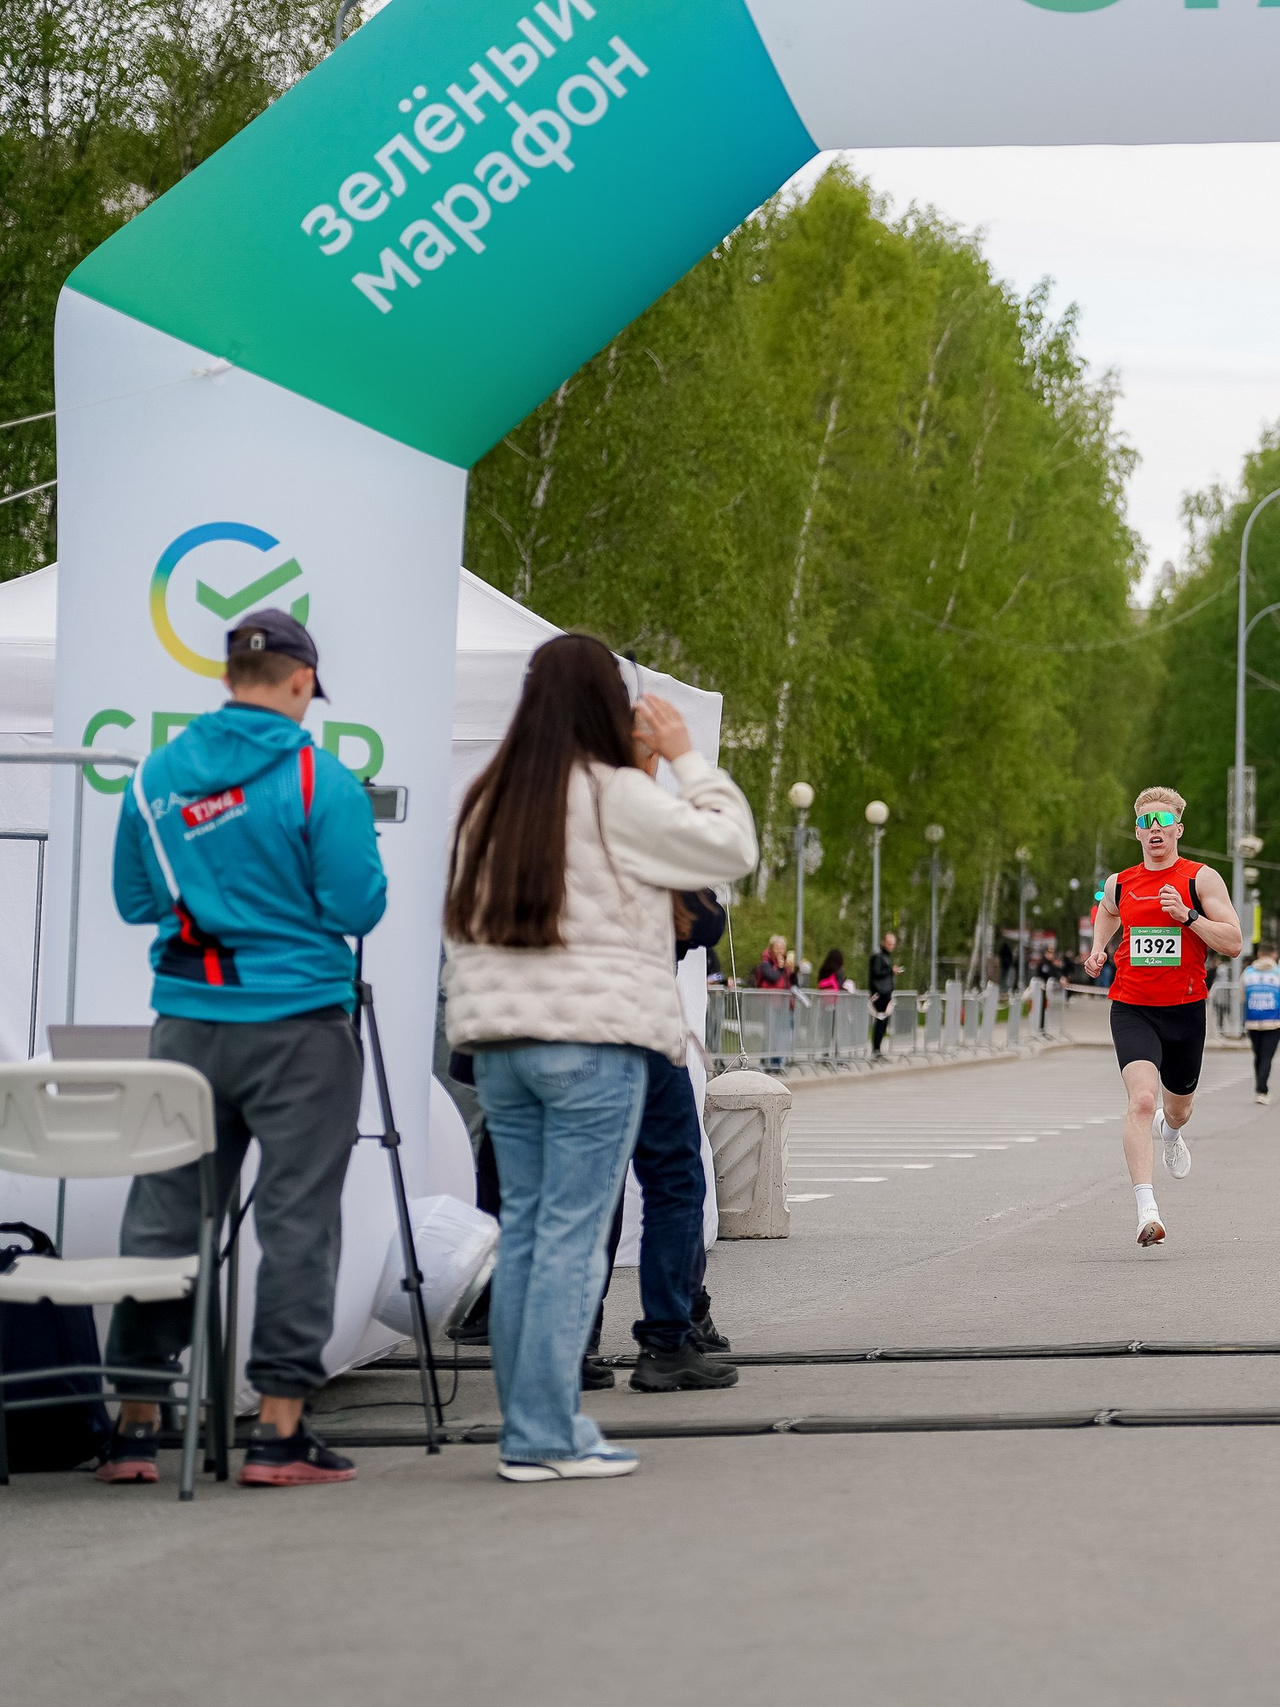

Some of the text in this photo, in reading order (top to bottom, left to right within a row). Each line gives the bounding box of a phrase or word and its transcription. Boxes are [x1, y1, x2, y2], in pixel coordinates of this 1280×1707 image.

[351, 35, 650, 314] марафон
[82, 708, 384, 795] СР
[1135, 938, 1176, 954] 1392
